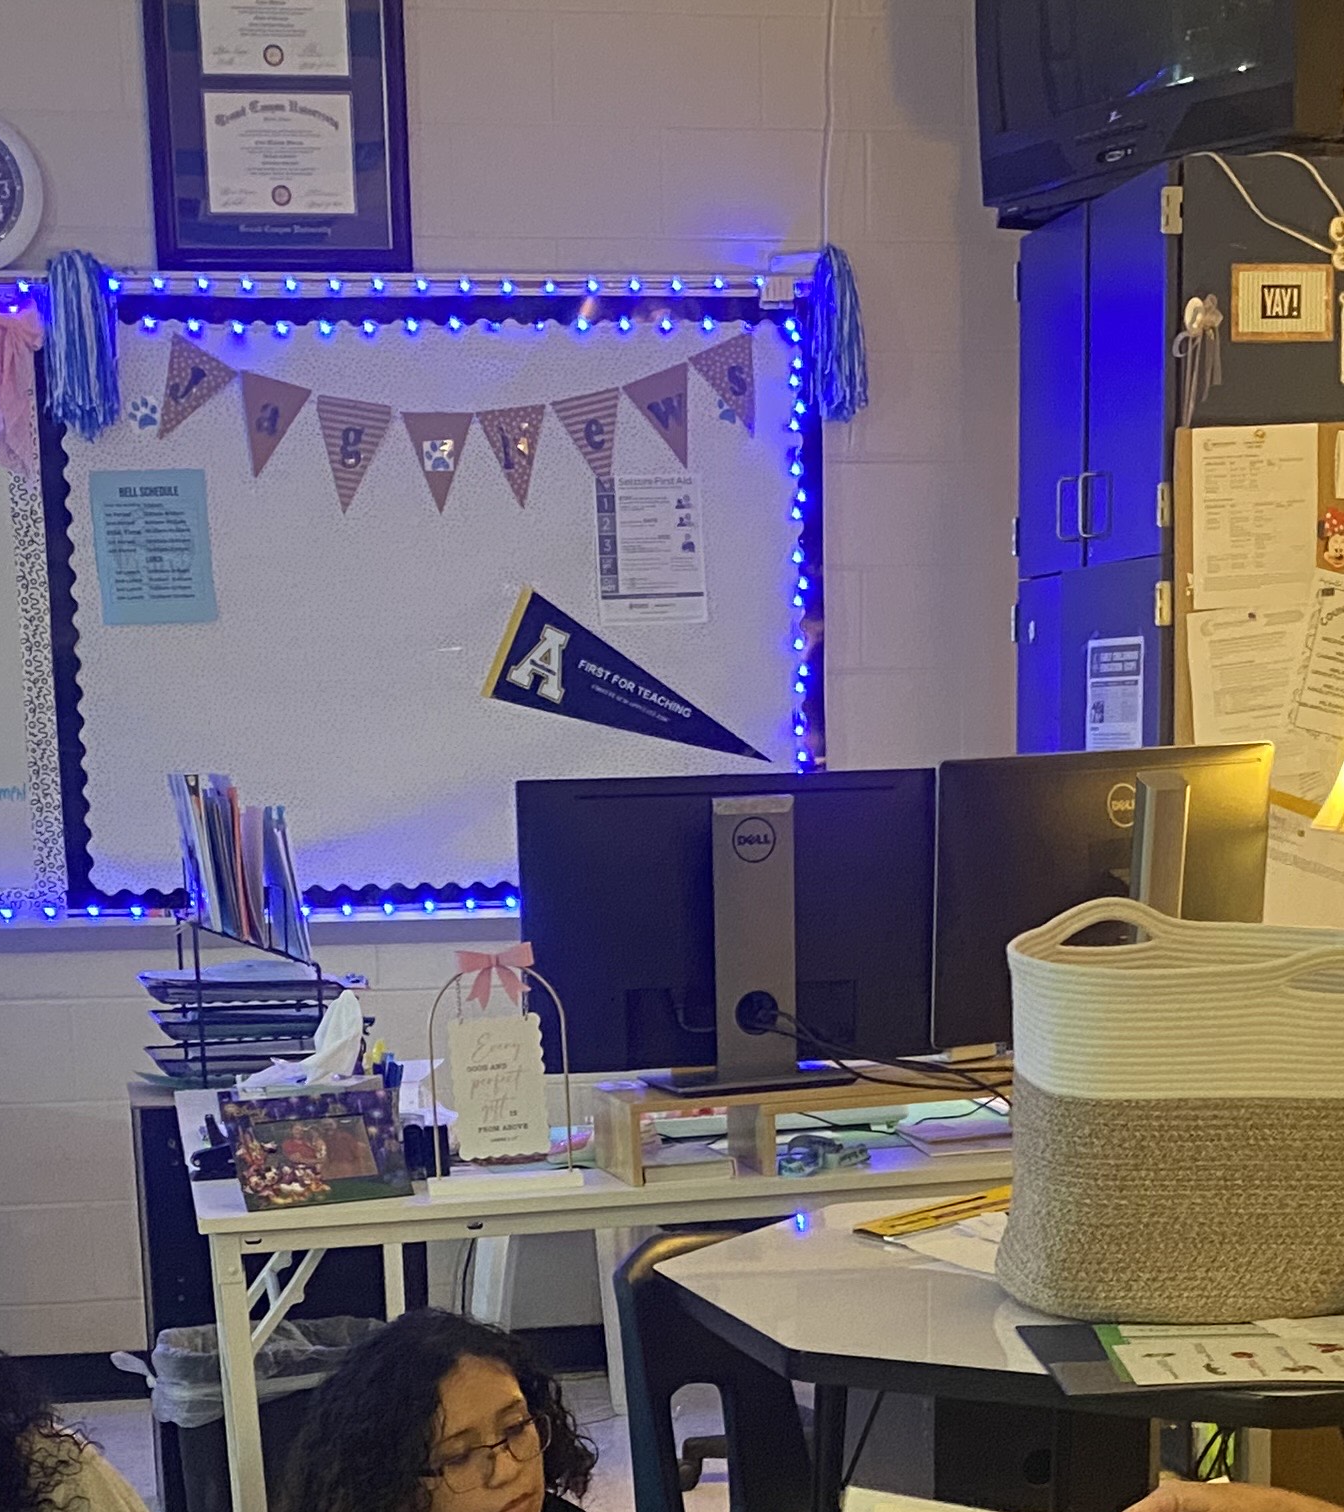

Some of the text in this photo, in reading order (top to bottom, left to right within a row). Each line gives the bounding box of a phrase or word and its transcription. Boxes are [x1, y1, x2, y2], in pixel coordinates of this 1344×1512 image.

[1263, 287, 1299, 317] YAY!
[654, 477, 675, 485] First
[676, 476, 693, 485] Aid
[118, 486, 180, 498] BELL SCHEDULE
[601, 518, 611, 531] 2
[603, 538, 612, 552] 3
[506, 623, 571, 704] A
[577, 659, 611, 682] FIRST
[610, 673, 636, 694] FOR
[637, 684, 693, 719] TEACHING
[737, 834, 771, 846] DELL
